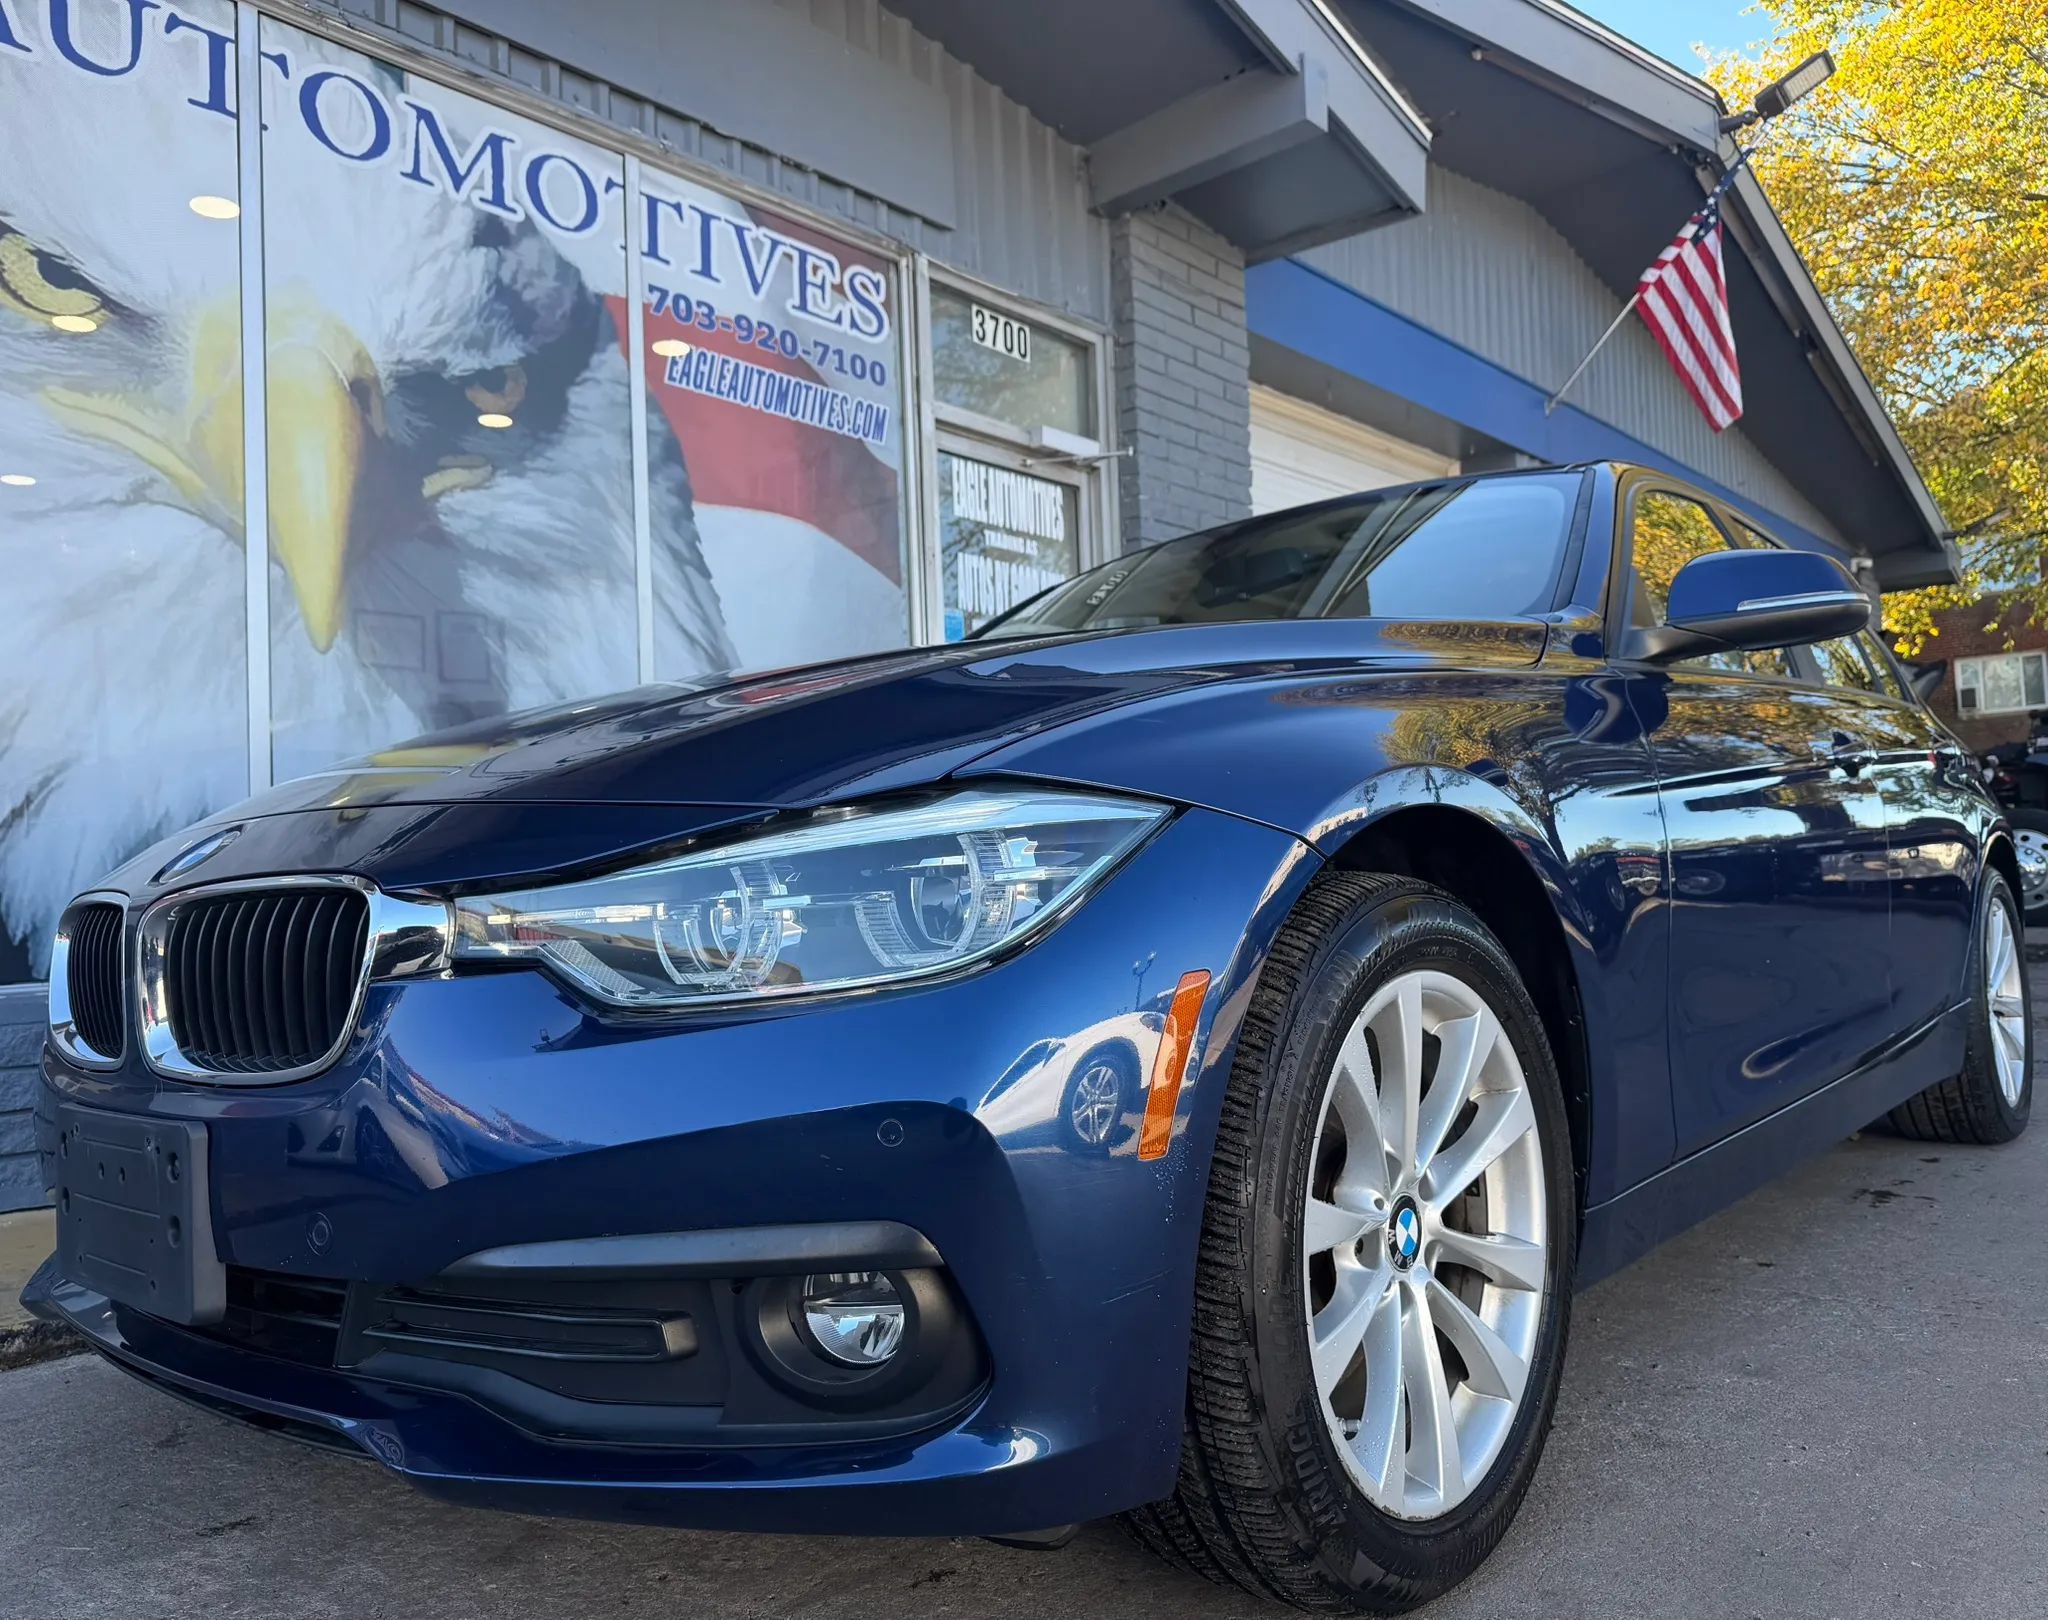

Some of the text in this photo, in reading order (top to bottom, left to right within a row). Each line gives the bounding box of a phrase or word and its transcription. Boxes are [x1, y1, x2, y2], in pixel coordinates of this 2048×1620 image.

[0, 0, 886, 338] UTOMOTIVES
[647, 283, 887, 387] 703-920-7100
[975, 309, 1028, 359] 3700
[667, 347, 887, 443] EAGLEAUTOMOTIVES.COM
[952, 457, 1064, 542] EAGLE AUTOMOTIVES
